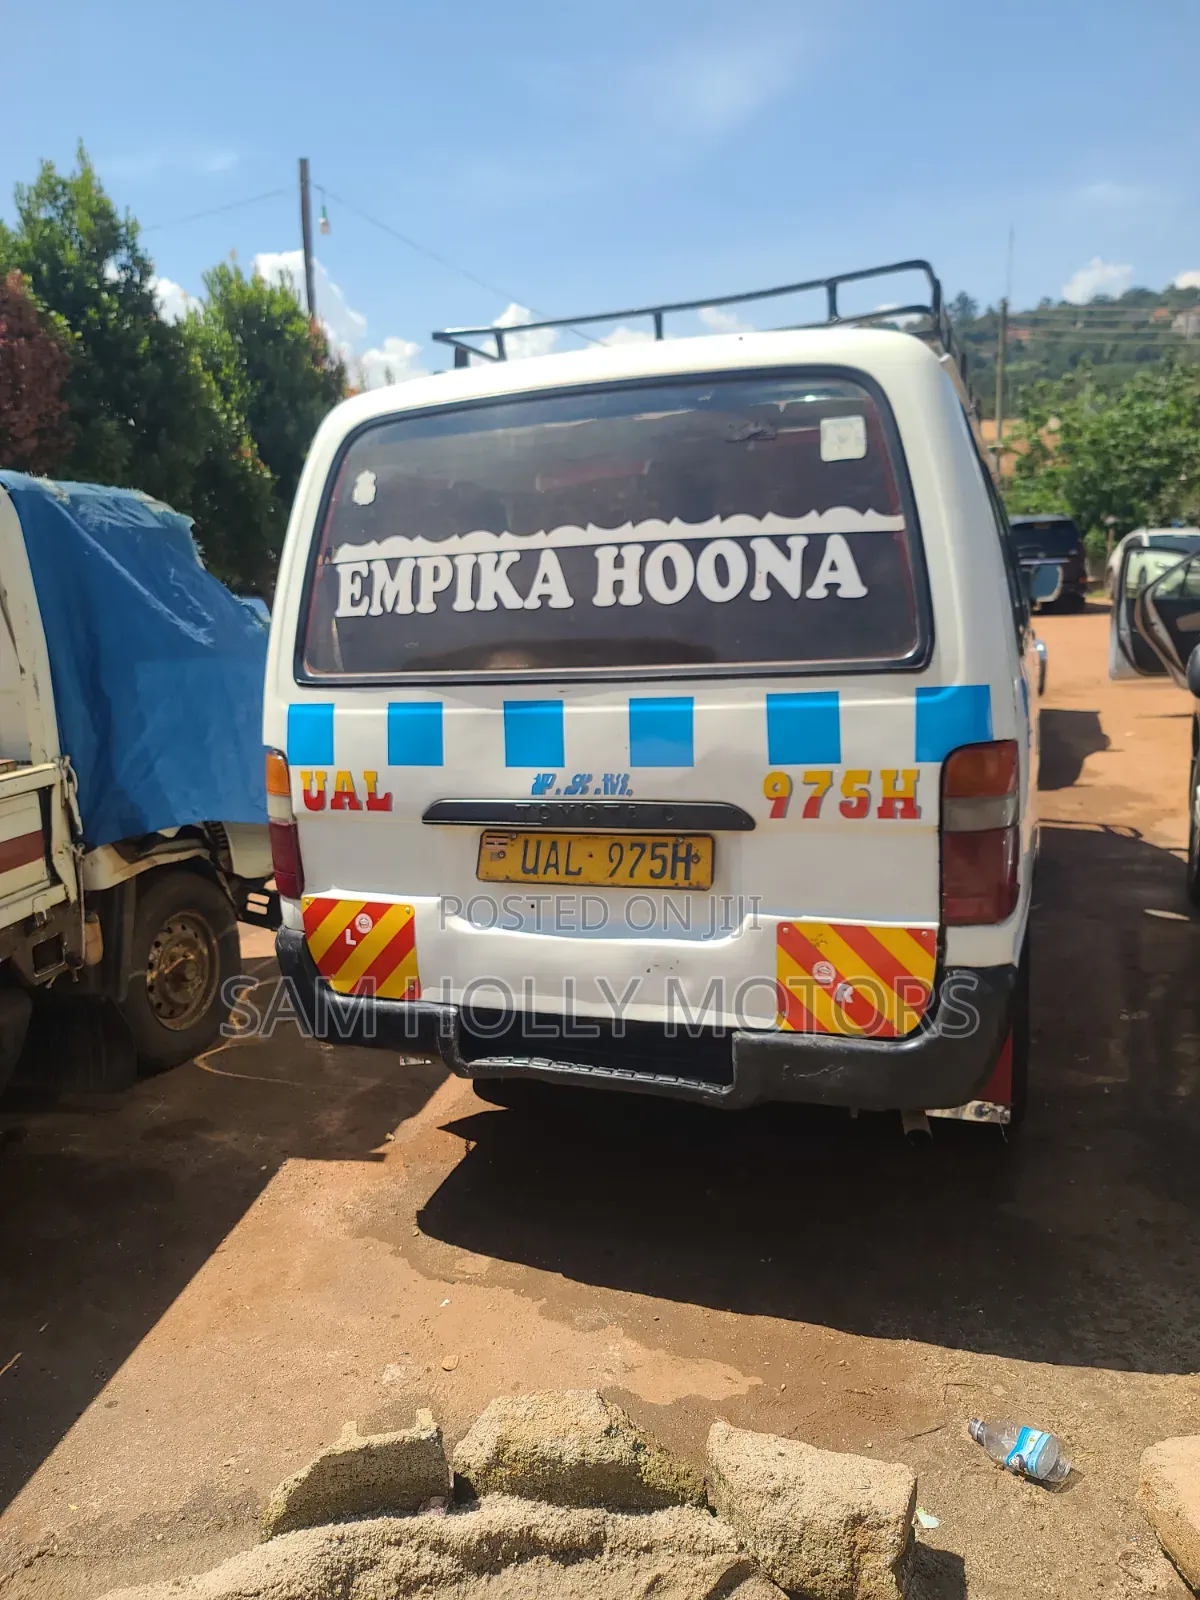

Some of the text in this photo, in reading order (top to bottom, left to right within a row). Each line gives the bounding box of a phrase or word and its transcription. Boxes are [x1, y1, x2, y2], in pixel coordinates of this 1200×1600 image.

[335, 533, 868, 618] EMPIKA HOONA
[300, 770, 393, 812] UAL
[763, 769, 921, 819] 975H
[521, 838, 693, 881] UAL 975H
